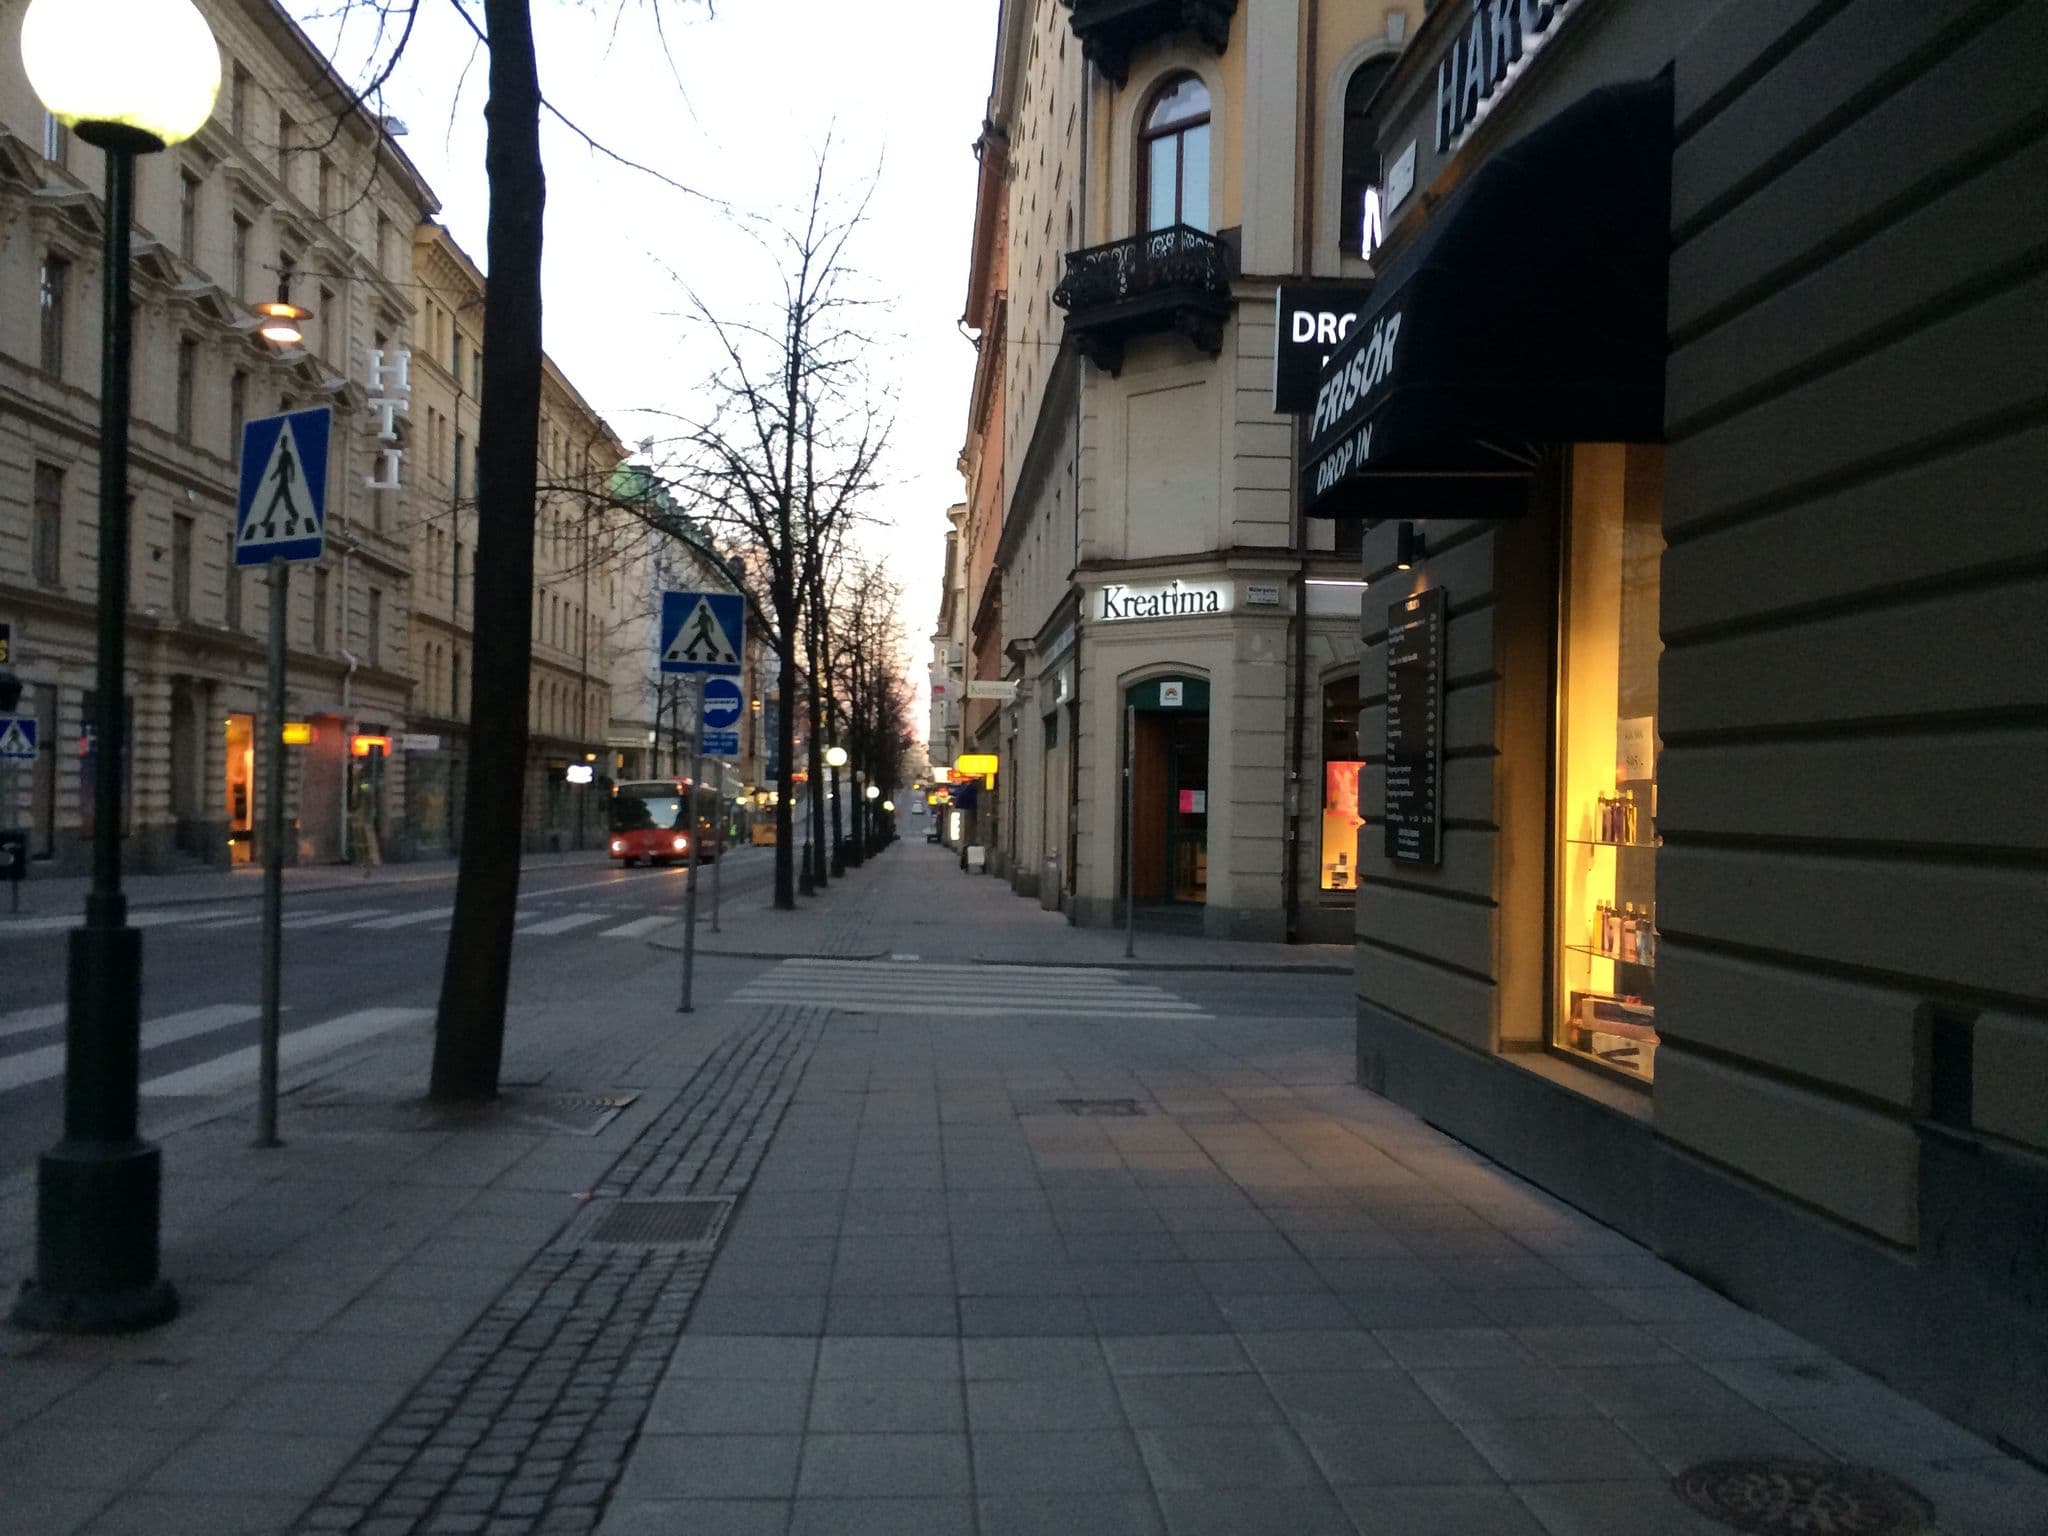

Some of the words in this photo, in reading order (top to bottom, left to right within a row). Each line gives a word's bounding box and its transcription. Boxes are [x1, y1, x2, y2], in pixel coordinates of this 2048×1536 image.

[1311, 312, 1402, 443] FRISÖR
[1316, 438, 1354, 496] DROP
[1355, 421, 1373, 469] IN
[1101, 581, 1220, 619] Kreatima
